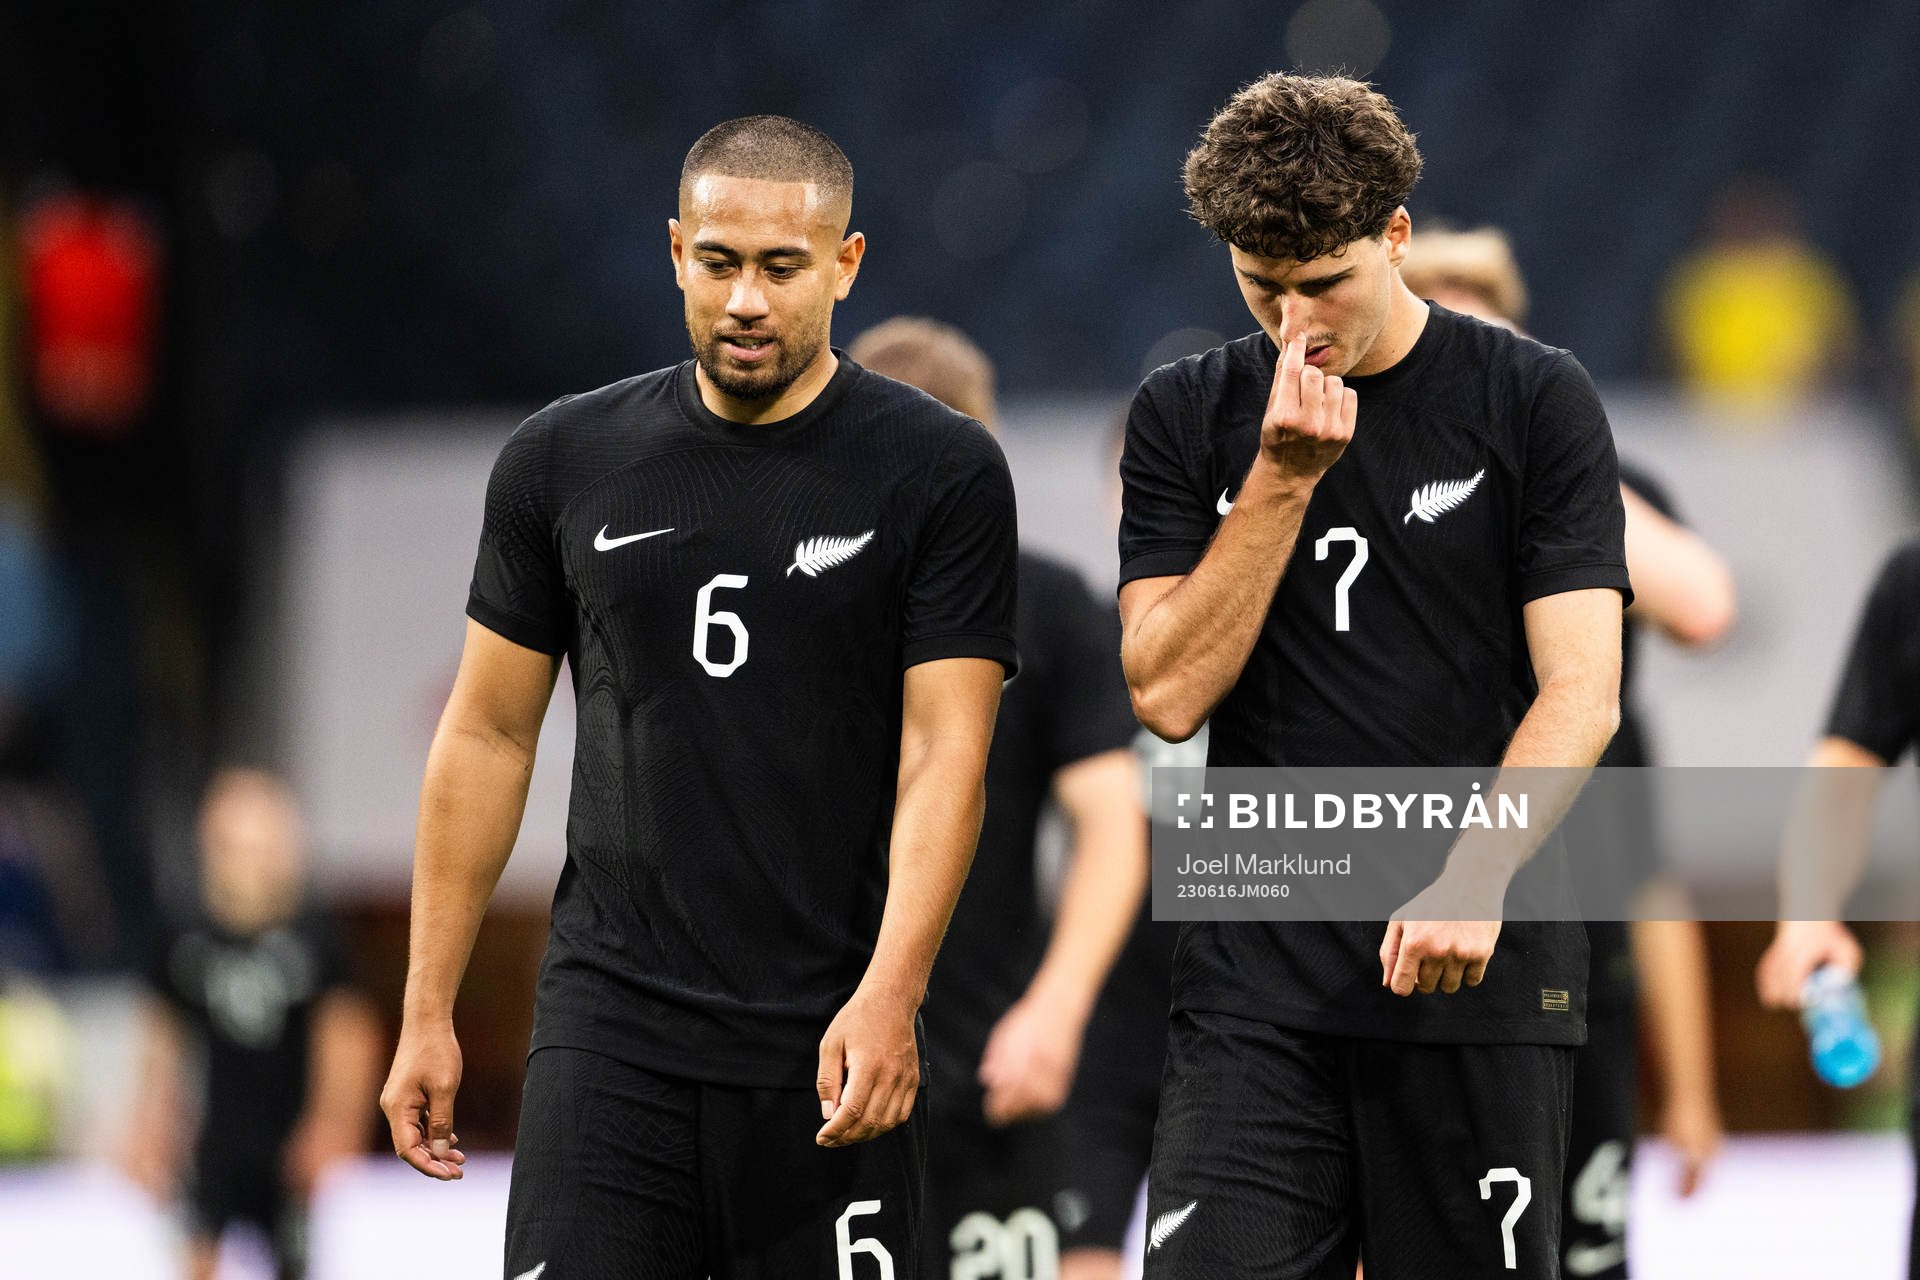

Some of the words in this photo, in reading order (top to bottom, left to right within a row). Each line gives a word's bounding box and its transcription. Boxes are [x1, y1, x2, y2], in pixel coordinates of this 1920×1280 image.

[692, 573, 749, 678] 6
[1314, 526, 1369, 632] 7
[835, 1199, 895, 1280] 6
[951, 1208, 1059, 1280] 20
[1478, 1167, 1532, 1270] 7
